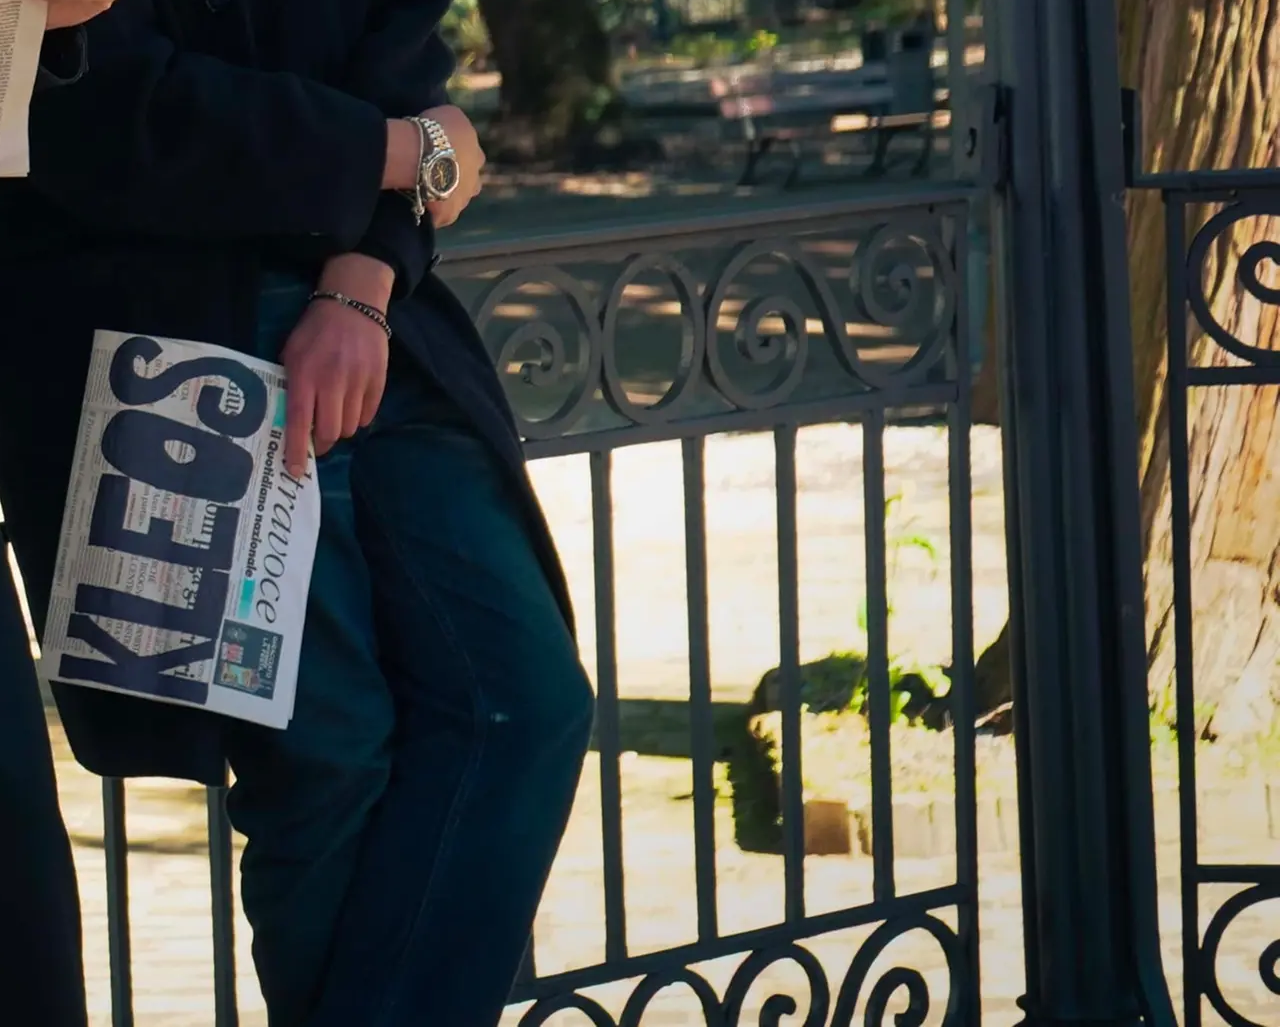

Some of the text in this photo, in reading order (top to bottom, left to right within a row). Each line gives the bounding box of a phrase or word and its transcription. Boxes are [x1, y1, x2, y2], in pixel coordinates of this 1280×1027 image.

[59, 336, 267, 705] KLEOS
[243, 429, 281, 578] il Quotidiano nazionale
